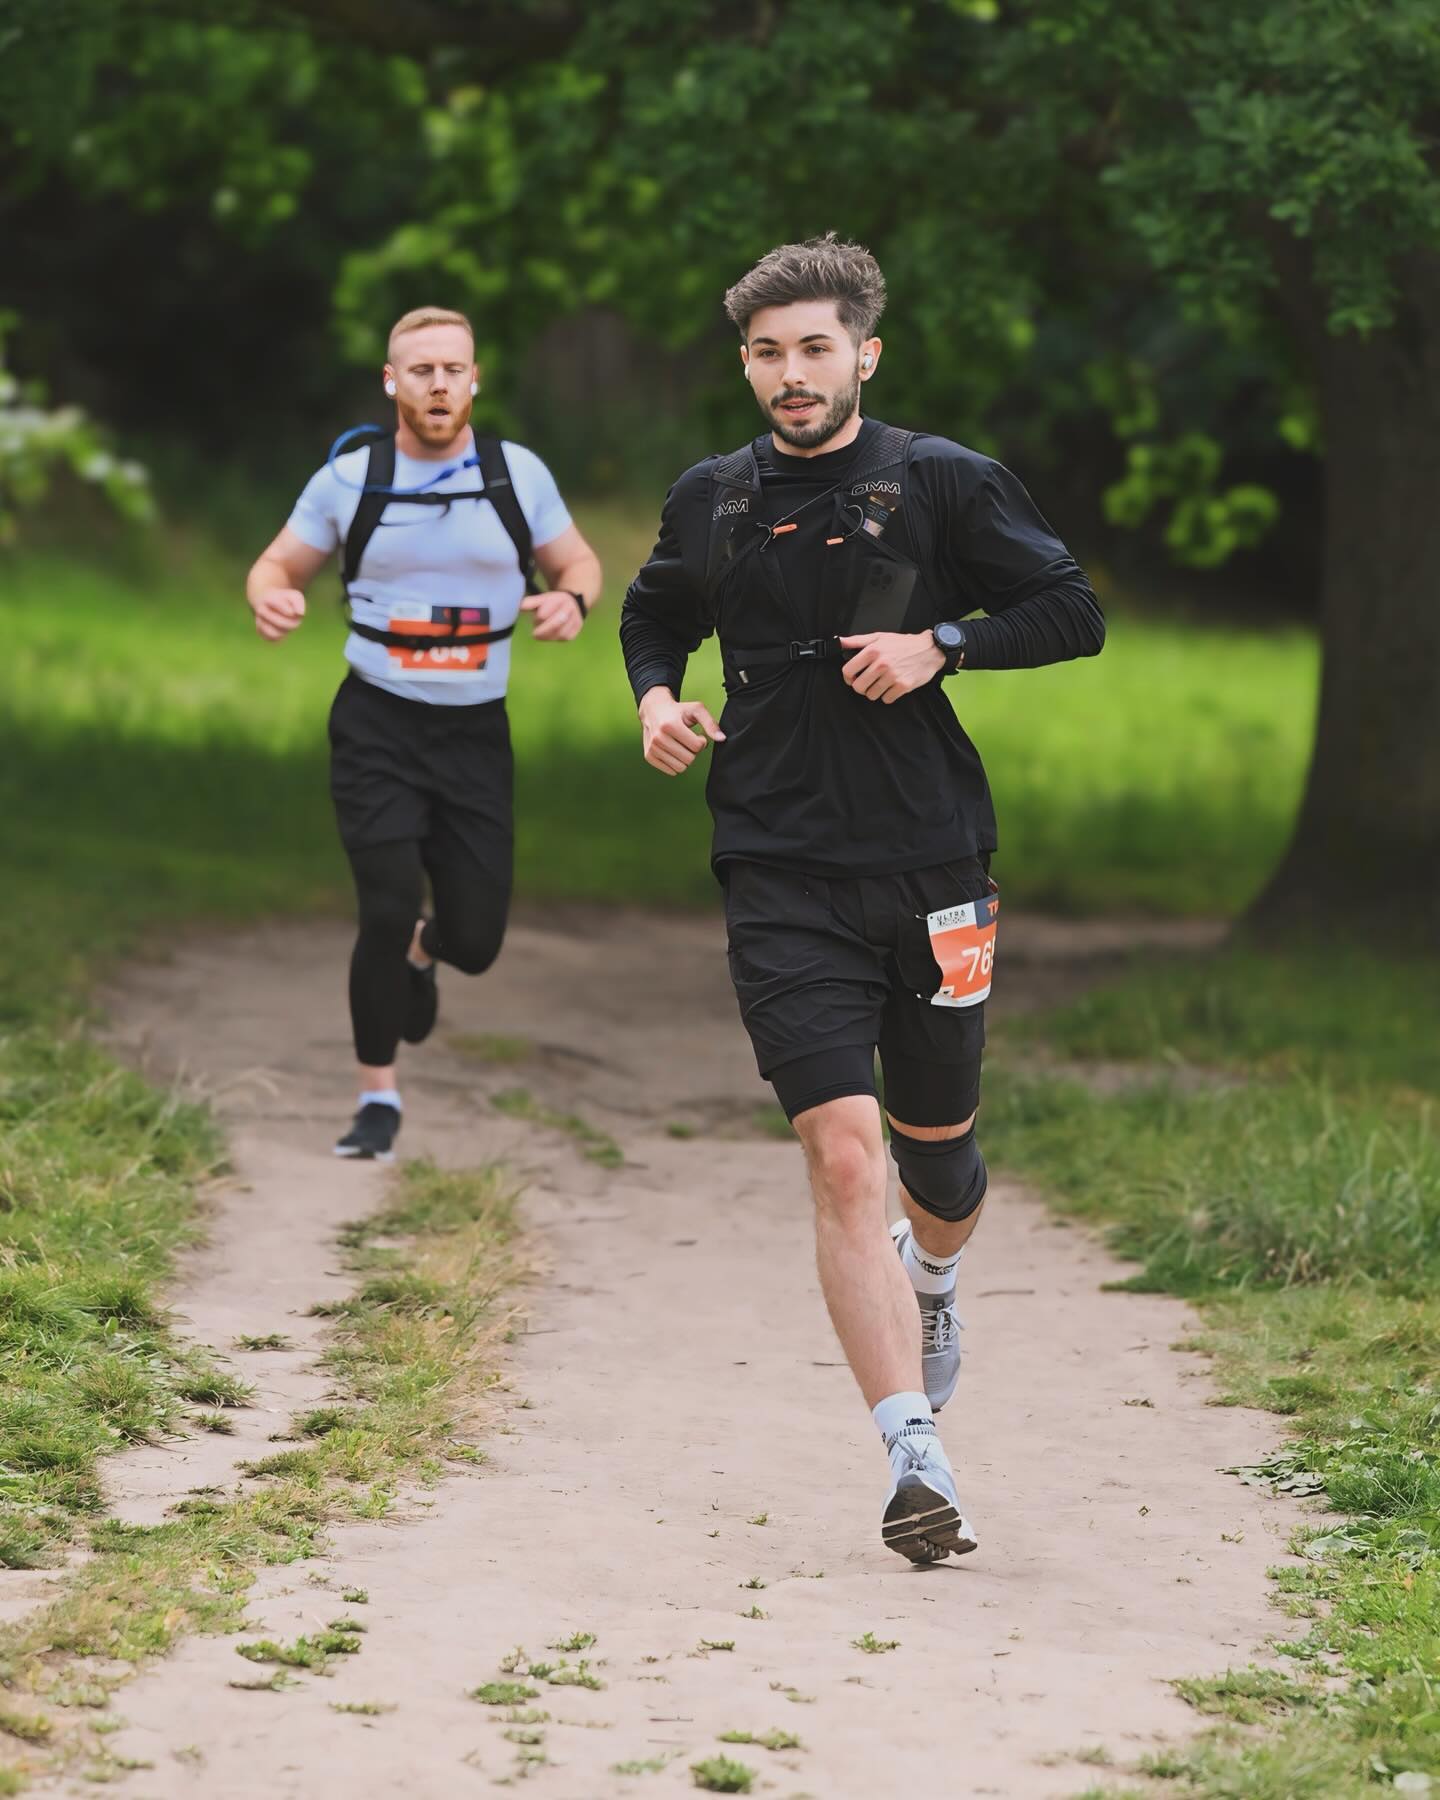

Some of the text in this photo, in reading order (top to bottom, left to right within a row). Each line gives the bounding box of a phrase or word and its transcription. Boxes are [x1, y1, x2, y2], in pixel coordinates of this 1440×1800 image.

[851, 480, 901, 496] OMM
[936, 909, 966, 922] ULTRA
[961, 936, 996, 983] 76
